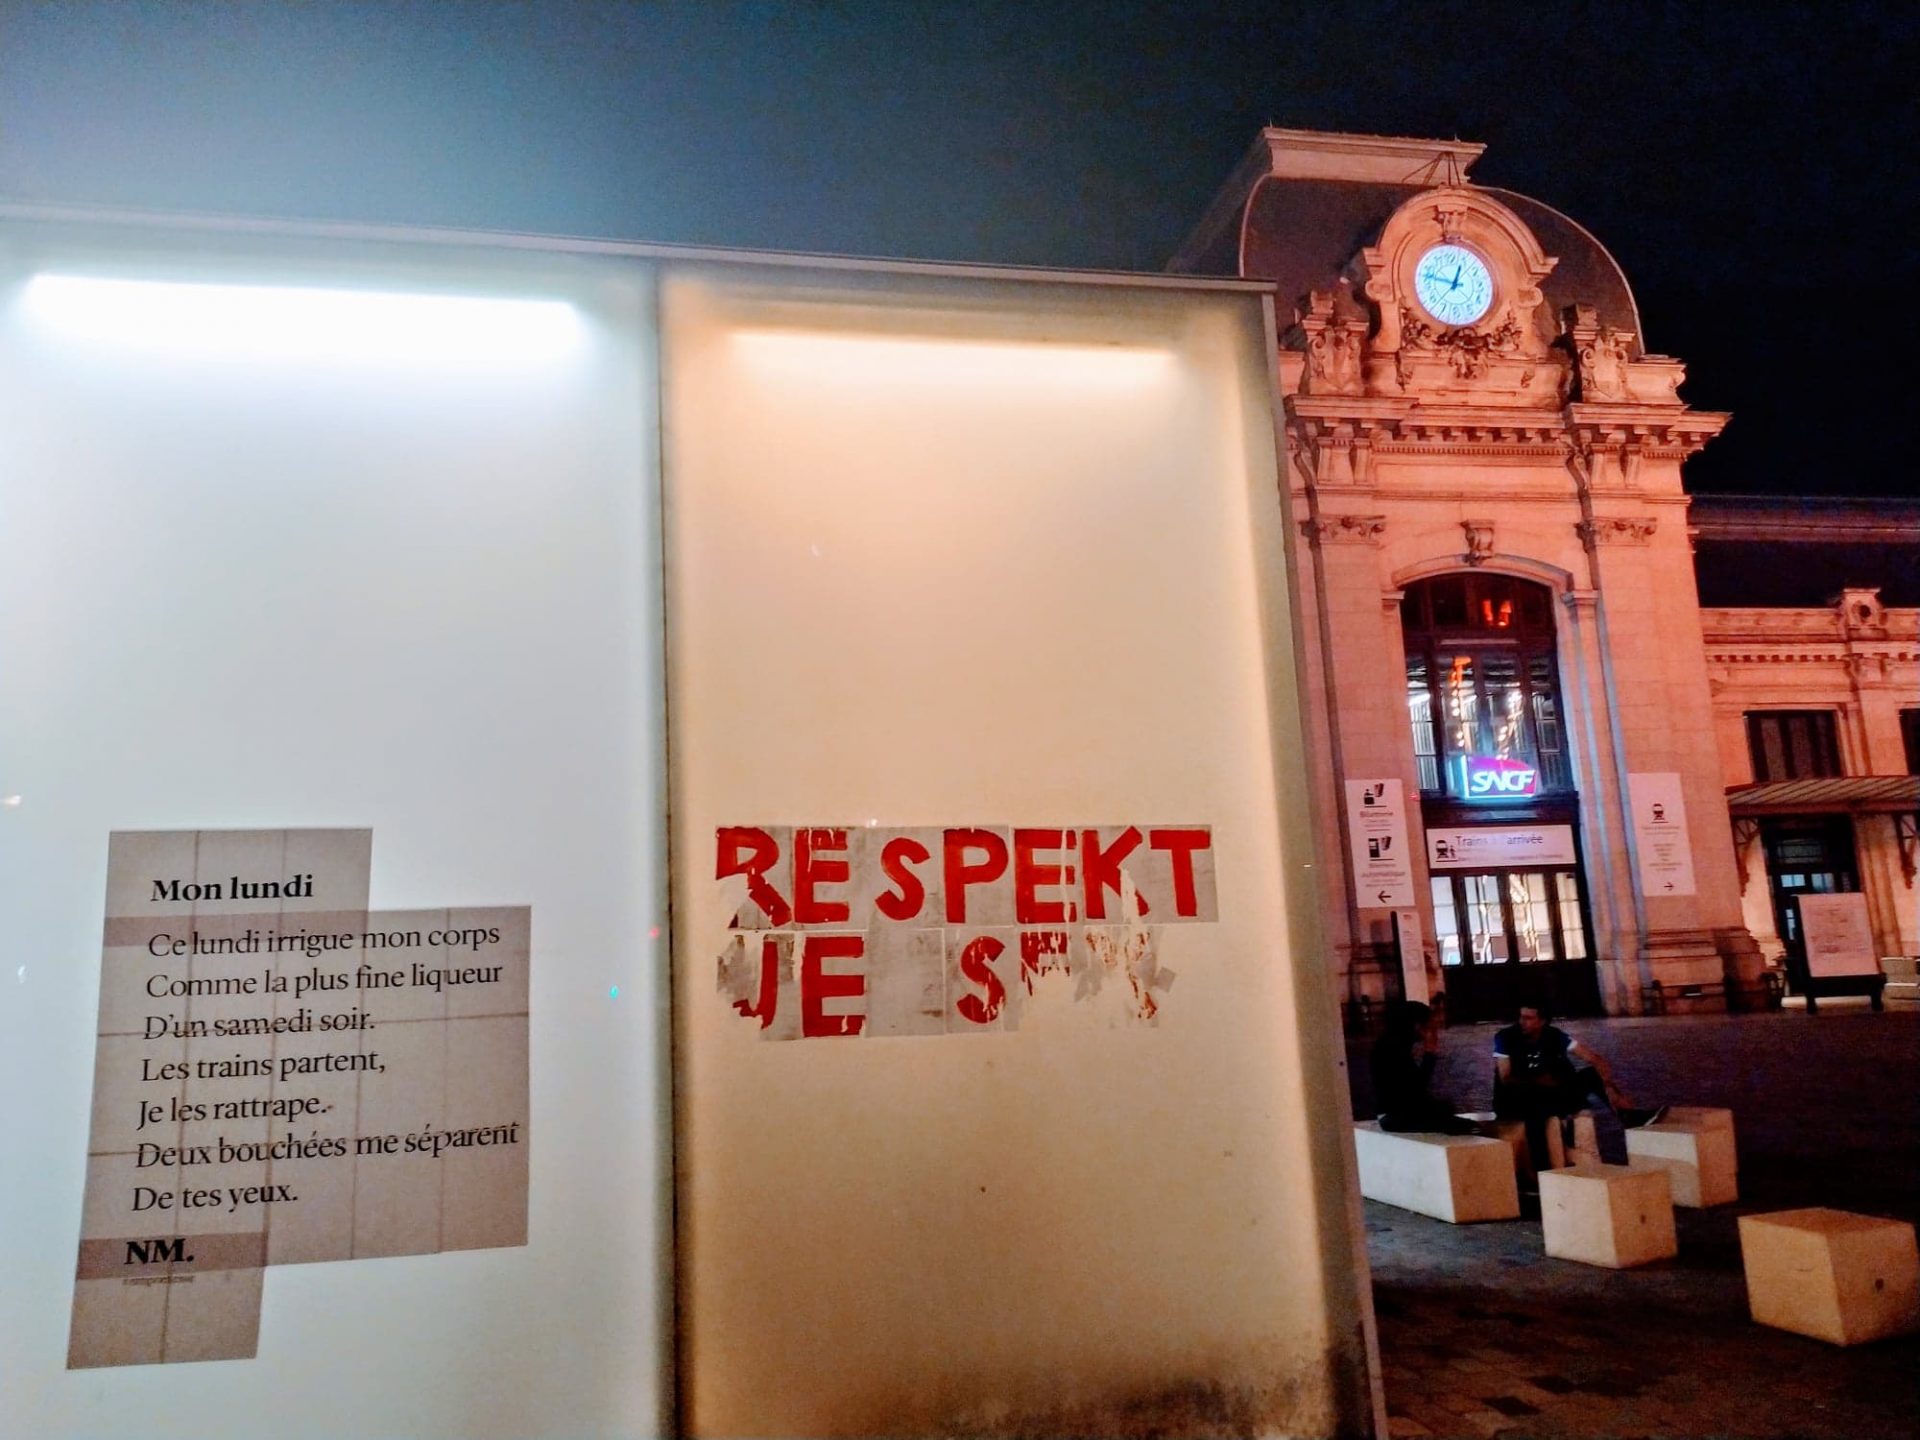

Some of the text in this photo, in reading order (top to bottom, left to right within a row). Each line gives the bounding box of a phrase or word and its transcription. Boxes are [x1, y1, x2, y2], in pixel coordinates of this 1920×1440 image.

[1471, 769, 1536, 792] SNCF
[150, 873, 314, 901] Mon lundi
[716, 826, 1212, 928] RESPEKT
[148, 925, 501, 957] Ce lundi irrigue mon corps
[146, 961, 504, 999] Comme la plus fine liqueur
[733, 936, 866, 1037] JE
[213, 1008, 313, 1037] samedi
[319, 1006, 376, 1032] soir.
[141, 1050, 387, 1082] Les trains partent,
[135, 1096, 328, 1131] Je les rattrape.
[135, 1121, 520, 1169] Deux bouchées me séparent
[131, 1184, 299, 1214] De tes yeux.
[124, 1238, 195, 1265] NM.
